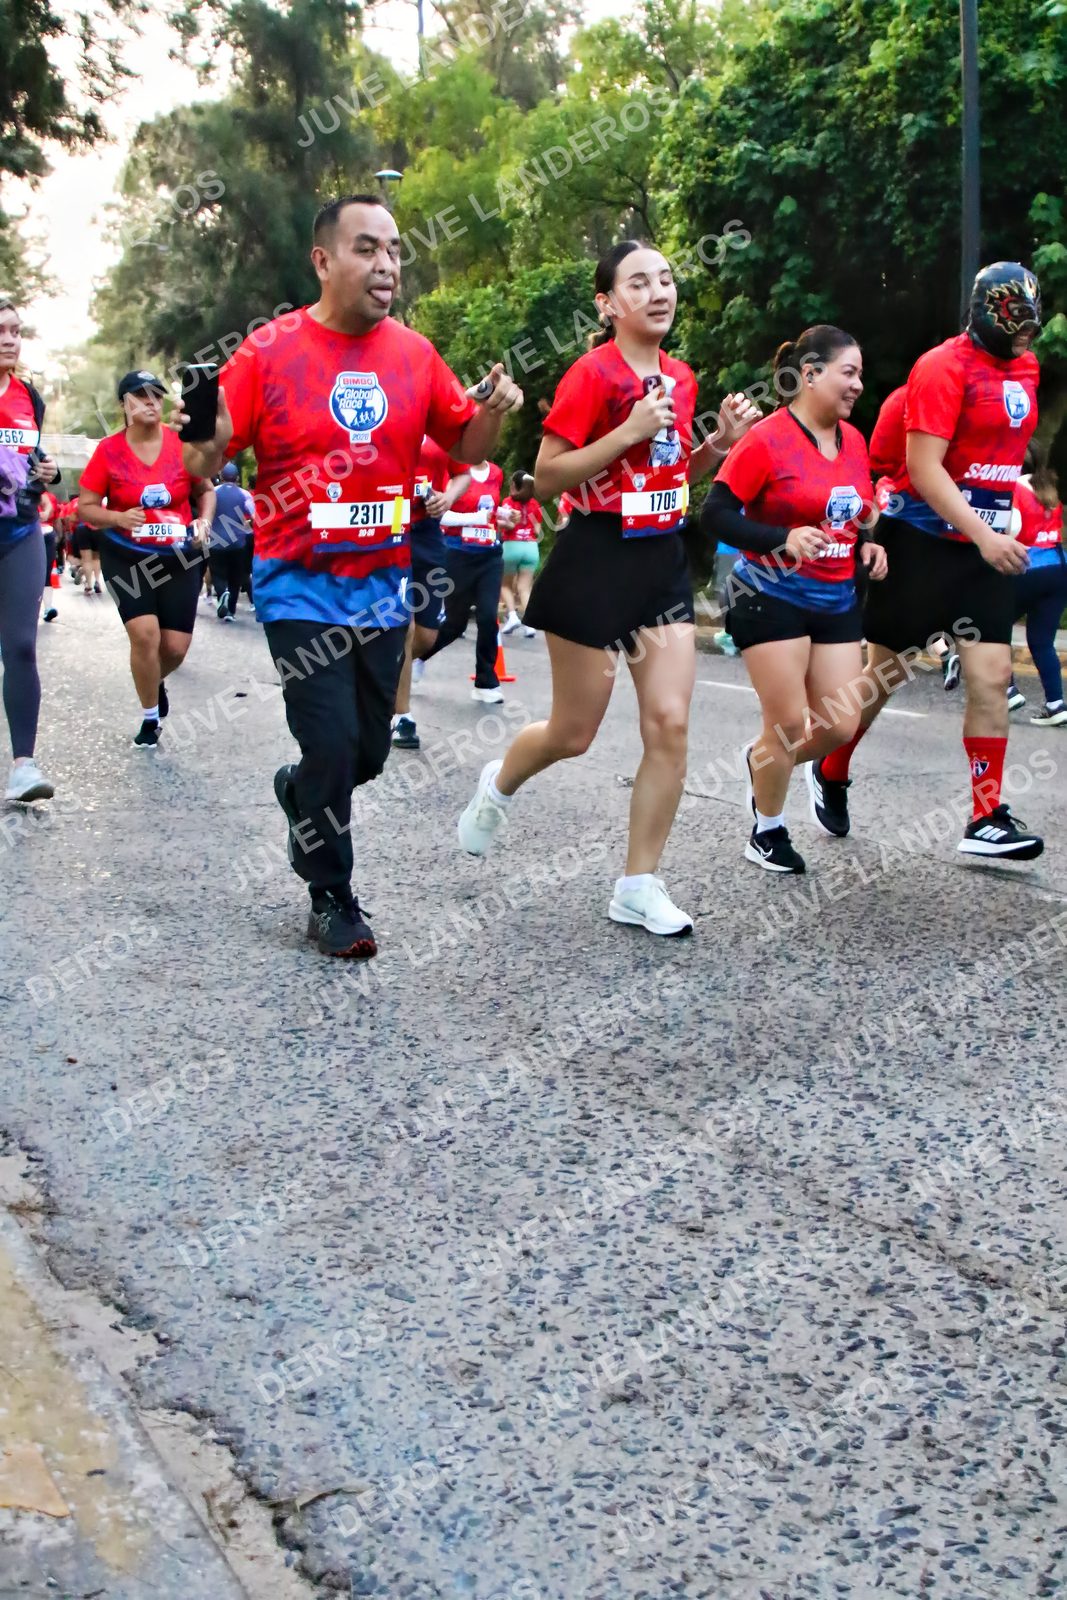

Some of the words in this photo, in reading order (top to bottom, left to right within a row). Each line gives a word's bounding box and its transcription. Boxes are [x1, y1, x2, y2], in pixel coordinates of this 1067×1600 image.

[342, 377, 373, 386] BIMBO
[344, 388, 374, 400] Global
[339, 399, 363, 409] Race
[650, 491, 677, 511] 1709
[349, 503, 384, 525] 2311
[974, 508, 997, 526] 979
[148, 524, 173, 536] 3266
